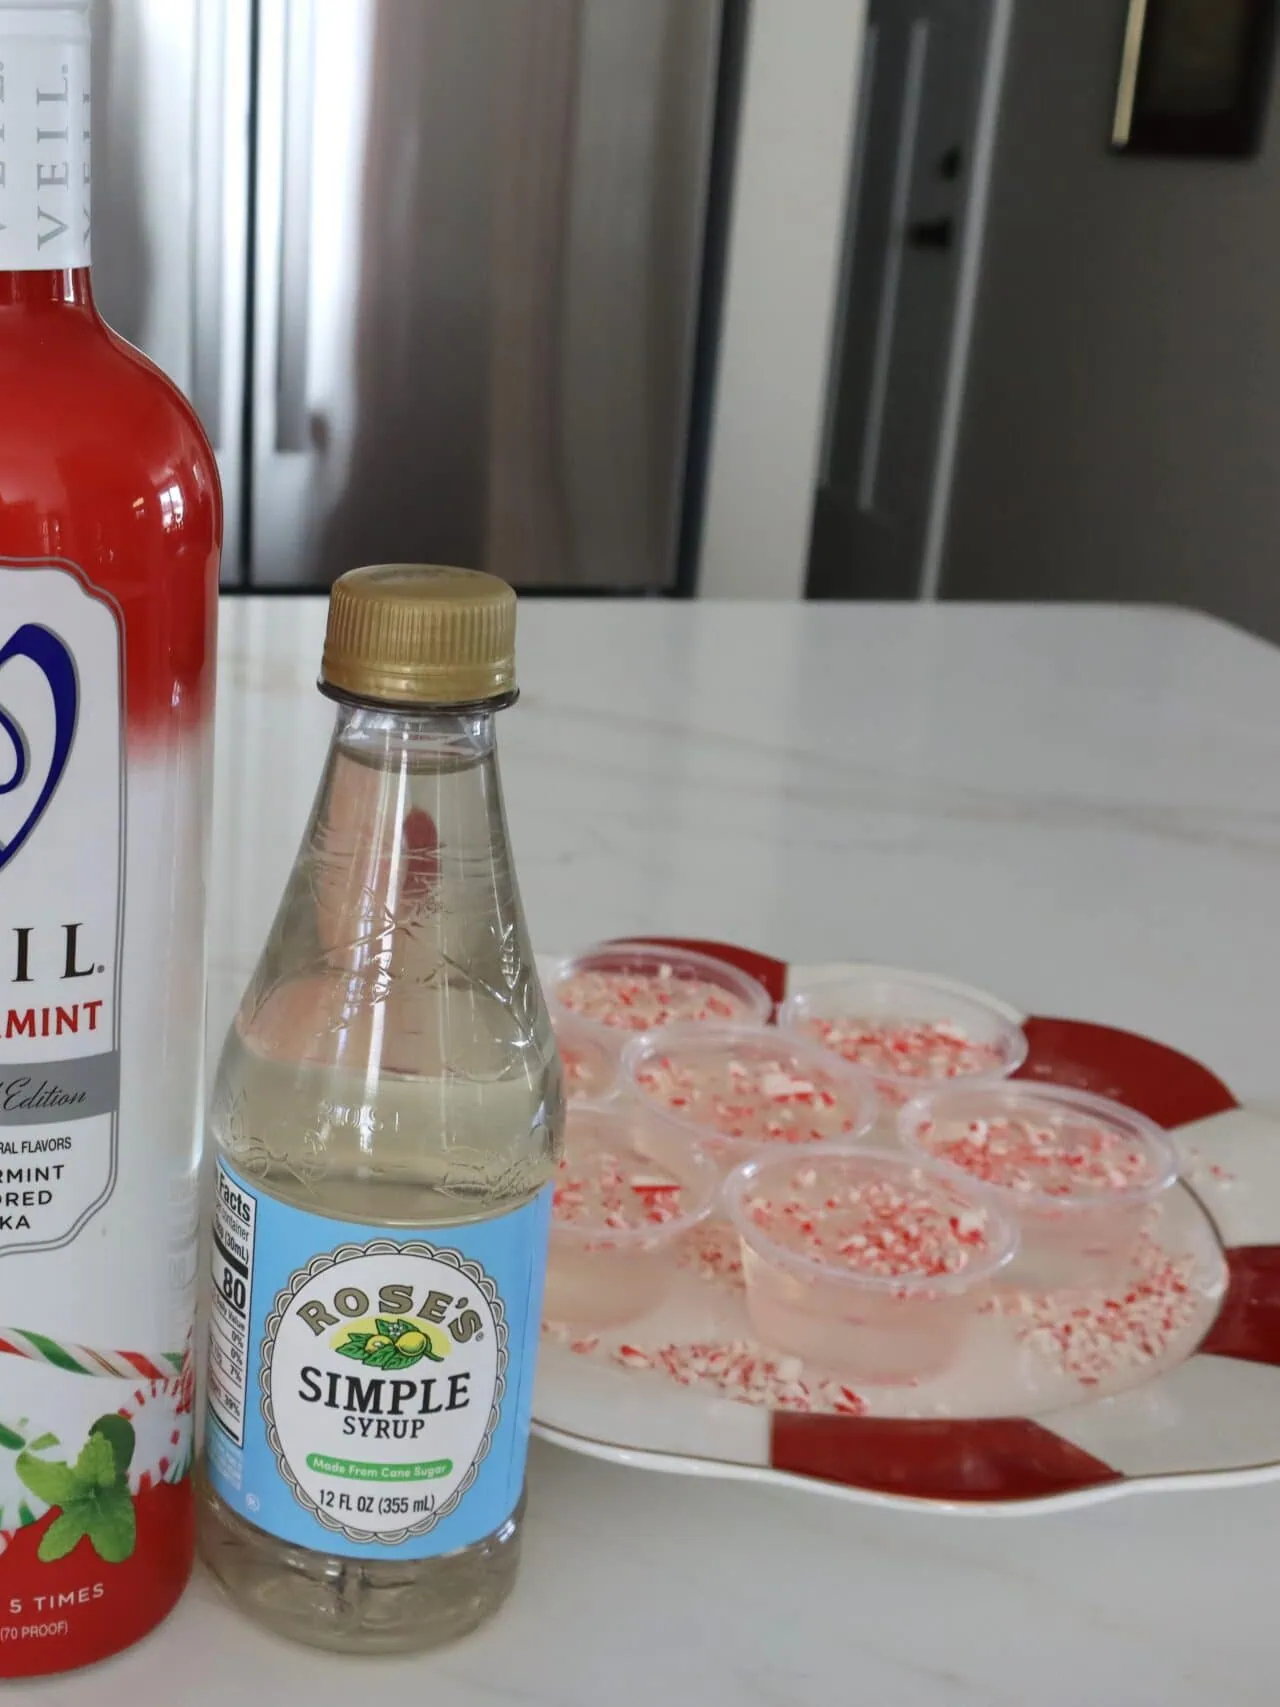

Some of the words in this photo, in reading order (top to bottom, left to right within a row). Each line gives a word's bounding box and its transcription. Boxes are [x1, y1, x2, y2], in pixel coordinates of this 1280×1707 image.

[36, 76, 69, 251] VEIL
[3, 1077, 87, 1111] Edition
[21, 1136, 72, 1153] FLAVORS
[219, 1173, 251, 1223] Facts
[223, 1266, 246, 1311] 80
[296, 1284, 484, 1343] ROSE'S
[298, 1366, 471, 1415] SIMPLE
[342, 1415, 426, 1439] SYRUP
[312, 1457, 345, 1474] Made
[348, 1465, 378, 1477] From
[381, 1467, 411, 1478] Cane
[414, 1464, 447, 1478] Sugar
[319, 1489, 335, 1508] 12
[339, 1493, 352, 1511] FL
[357, 1495, 375, 1513] OZ
[378, 1496, 408, 1515] (355
[413, 1494, 435, 1513] mL)
[33, 1583, 105, 1612] TIMES
[0, 1627, 18, 1643] (70
[21, 1620, 69, 1639] PROOF)
